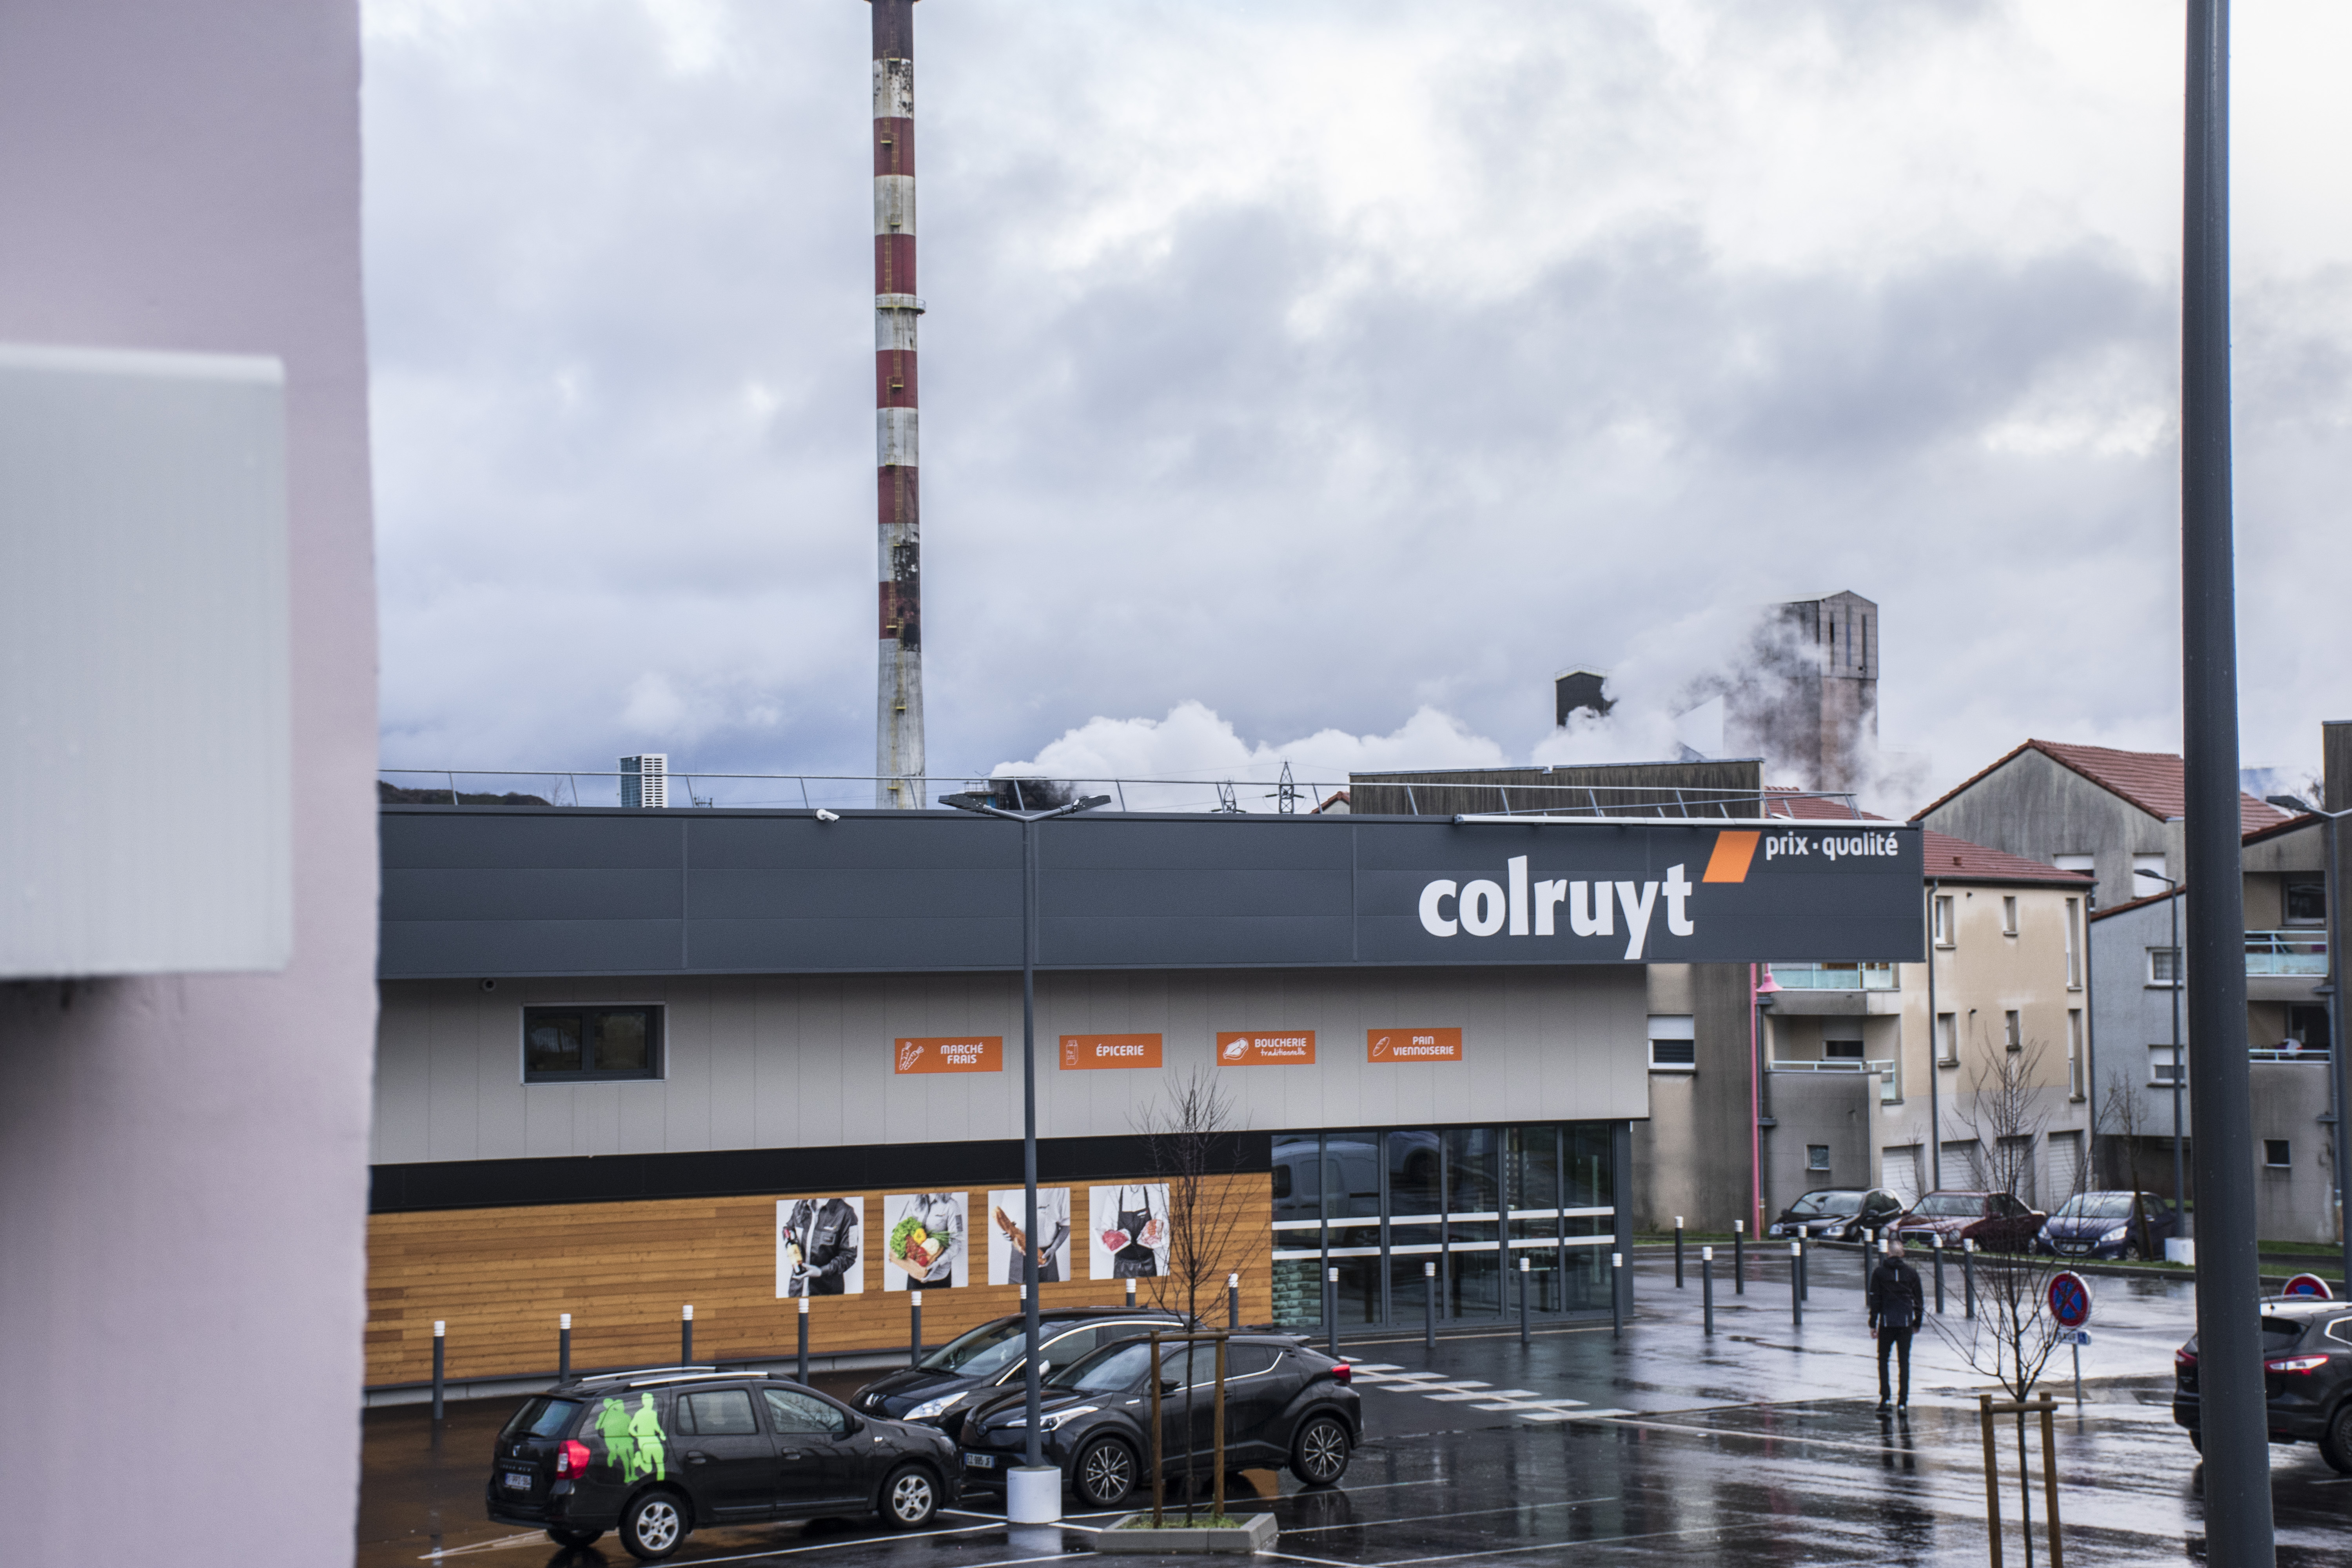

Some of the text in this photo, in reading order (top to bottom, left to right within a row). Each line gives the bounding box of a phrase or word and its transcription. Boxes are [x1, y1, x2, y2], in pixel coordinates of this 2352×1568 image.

[1418, 855, 1694, 960] colruyt
[1254, 1038, 1307, 1047] BOUCHERIE
[1412, 1036, 1434, 1045] PAIN
[940, 1042, 984, 1054] MARCHÉ
[1096, 1043, 1144, 1056] ÉPICERIE
[1261, 1047, 1306, 1056] traditionnelle
[1393, 1045, 1454, 1056] VIENNOISERIE
[947, 1054, 977, 1064] FRAIS
